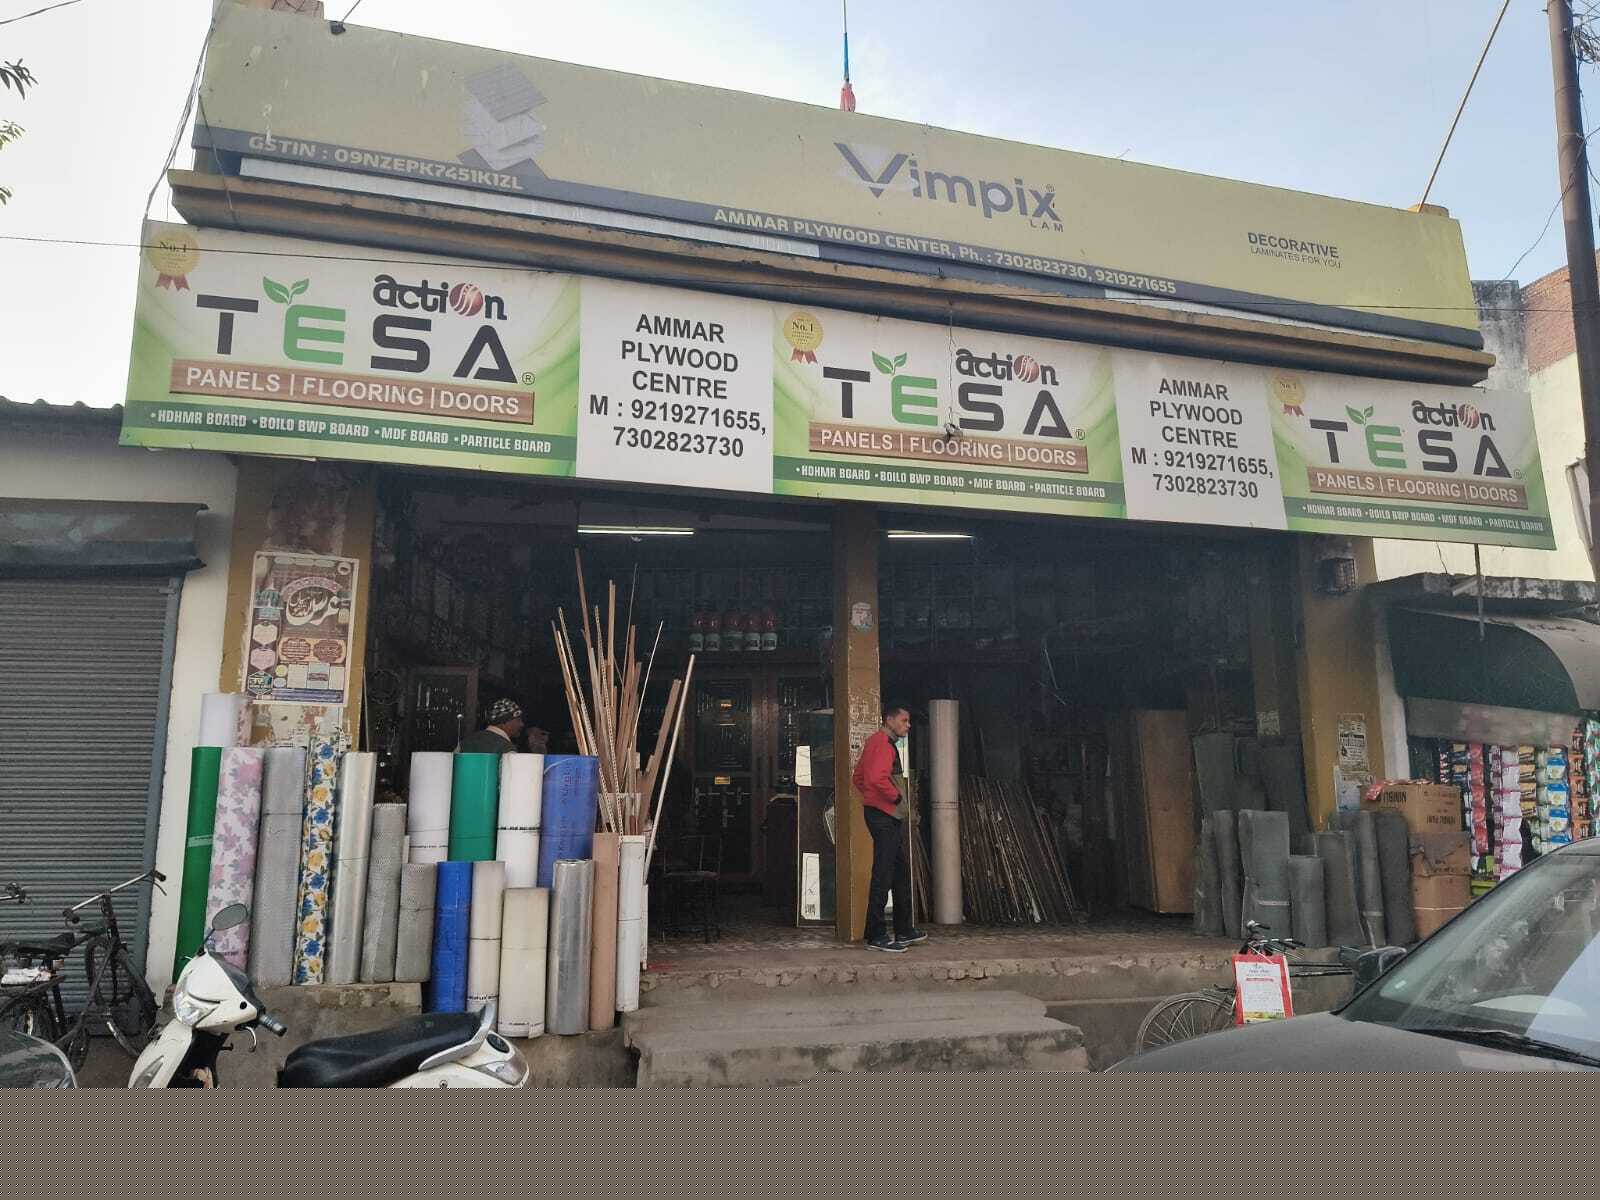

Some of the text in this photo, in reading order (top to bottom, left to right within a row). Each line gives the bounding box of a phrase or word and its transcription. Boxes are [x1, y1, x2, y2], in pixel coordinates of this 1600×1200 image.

[249, 135, 316, 157] GSTIN
[833, 142, 1061, 222] Vimpix
[1030, 219, 1064, 233] LAM
[714, 208, 789, 233] AMMAR
[794, 221, 880, 246] PLYWOOD
[885, 234, 957, 260] CENTER,
[995, 252, 1093, 282] 7302823730,
[1095, 269, 1177, 294] 9219271655
[1248, 232, 1340, 259] DECORATIVE
[196, 294, 518, 384] TESA
[636, 313, 725, 344] AMMAR
[621, 340, 739, 373] PLYWOOD
[187, 366, 520, 416] PANELS FLOORING DOORS
[632, 370, 728, 400] CENTRE
[1159, 378, 1230, 401] AMMAR
[589, 394, 609, 416] M
[631, 398, 766, 436] 9219271655,
[823, 366, 1074, 439] TESA
[1150, 400, 1243, 425] PLYWOOD
[206, 412, 247, 428] BOARD
[298, 419, 326, 434] BWP
[329, 422, 369, 437] BOARD
[381, 426, 407, 441] MDF
[410, 429, 449, 444] BOARD
[461, 434, 512, 450] PARTICLE
[514, 439, 552, 453] BOARD
[613, 426, 744, 458] 7302823730
[821, 429, 1077, 466] PANELS FLOORING DOORS
[1161, 426, 1239, 449] CENTRE
[1131, 446, 1147, 465] M
[1164, 449, 1273, 479] 9219271655,
[1310, 419, 1513, 480] TESA
[839, 467, 871, 481] BOARD
[909, 472, 932, 485] BWP
[934, 475, 964, 488] BOARD
[974, 478, 993, 489] MDF
[996, 479, 1026, 492] BOARD
[1034, 483, 1075, 496] PARTICLE
[1076, 486, 1106, 498] BOARD
[1152, 473, 1259, 498] 7302823730
[1317, 472, 1518, 503] PANELS FLOORING DOORS
